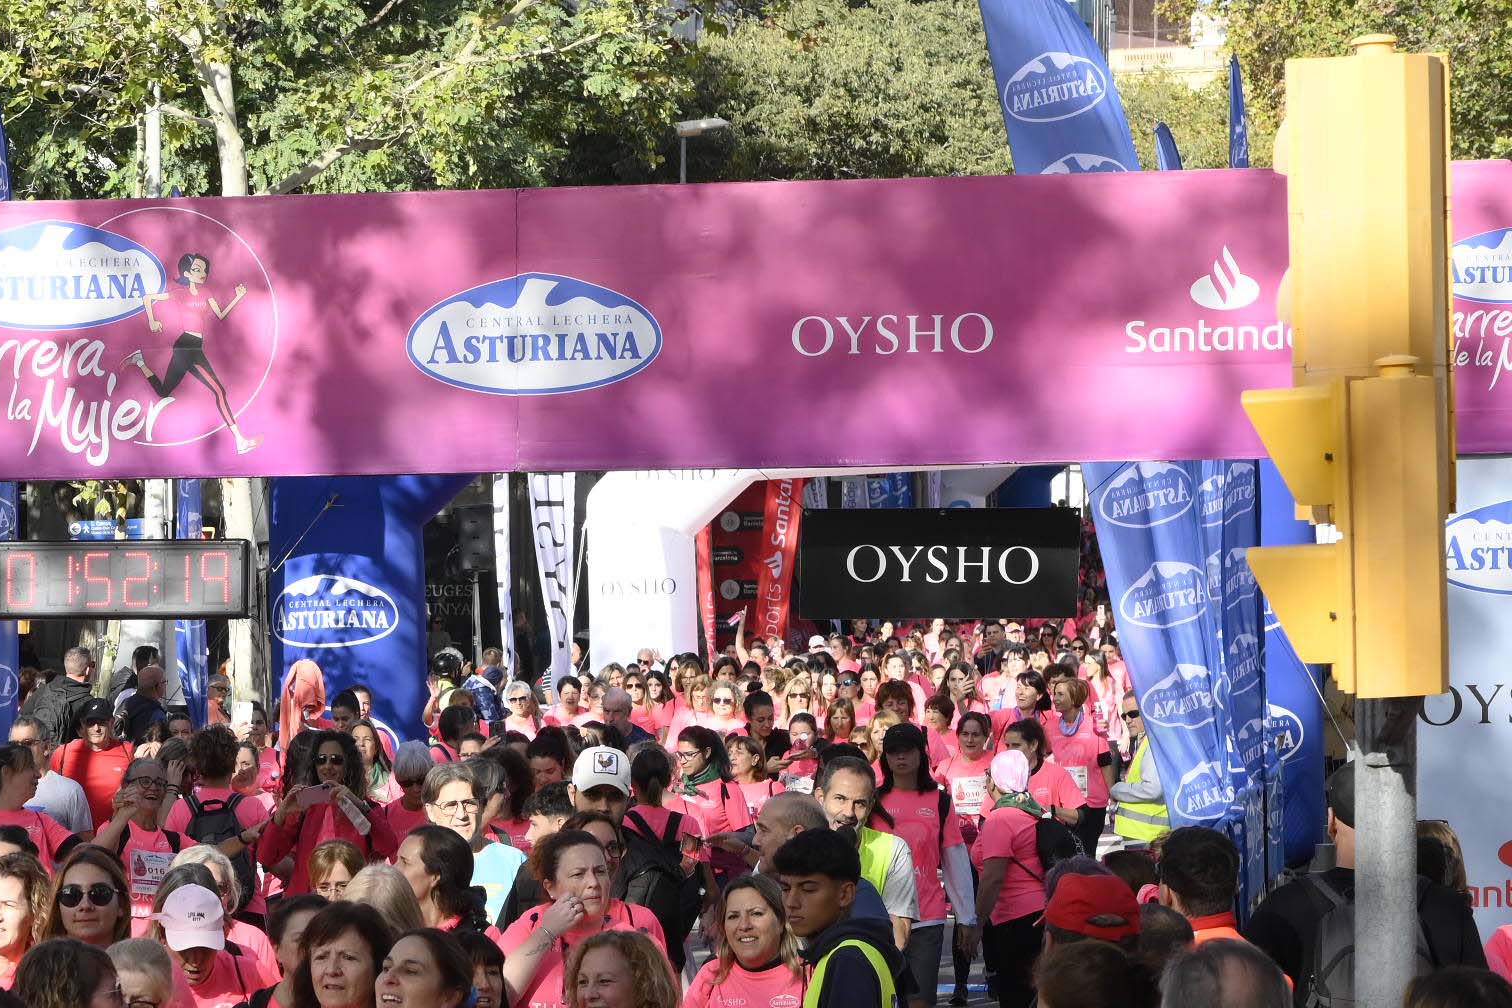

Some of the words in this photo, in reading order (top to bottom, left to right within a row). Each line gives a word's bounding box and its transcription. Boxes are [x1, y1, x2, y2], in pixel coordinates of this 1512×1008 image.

[466, 315, 544, 329] CENTRAL
[553, 313, 633, 326] LECHERA
[791, 313, 993, 356] OYSHO
[426, 320, 642, 364] ASTURIANA
[1476, 339, 1493, 366] la
[8, 383, 31, 420] la
[26, 373, 175, 466] Mujer
[6, 552, 230, 607] 01:52:19
[846, 544, 1039, 584] OYSHO
[277, 607, 390, 632] ASTURIANA
